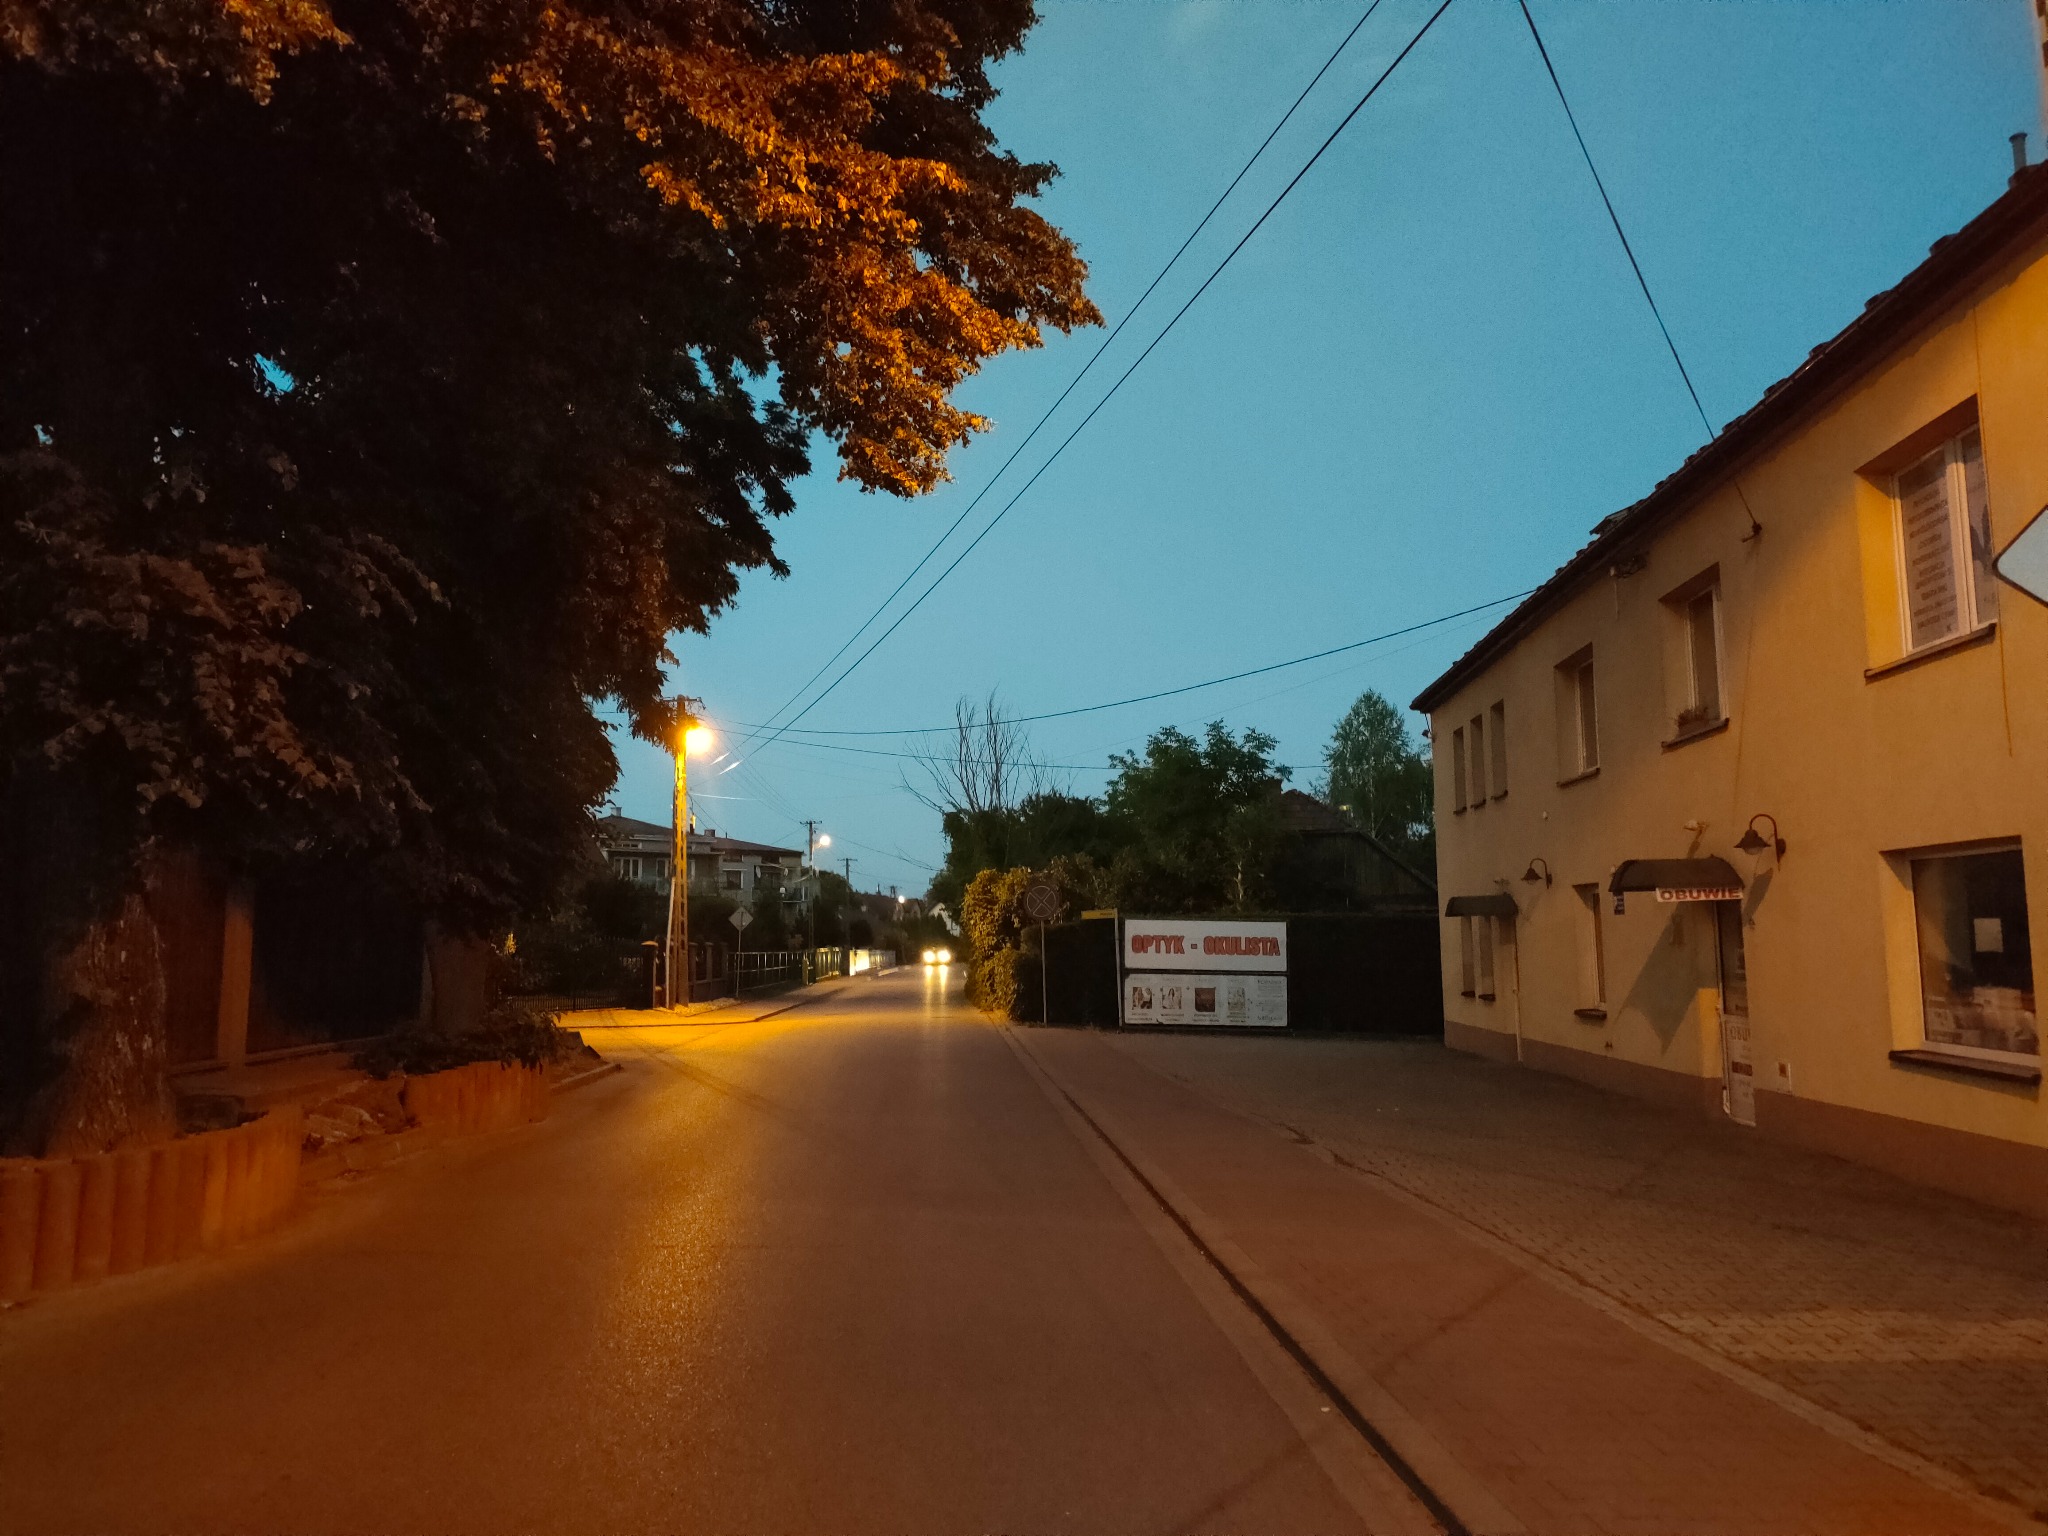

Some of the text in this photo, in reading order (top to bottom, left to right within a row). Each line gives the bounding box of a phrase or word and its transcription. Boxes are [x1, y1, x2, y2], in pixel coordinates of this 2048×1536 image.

[1659, 887, 1741, 901] OBUWIE
[1131, 934, 1185, 955] OPTYK
[1203, 935, 1281, 956] OKULISTA
